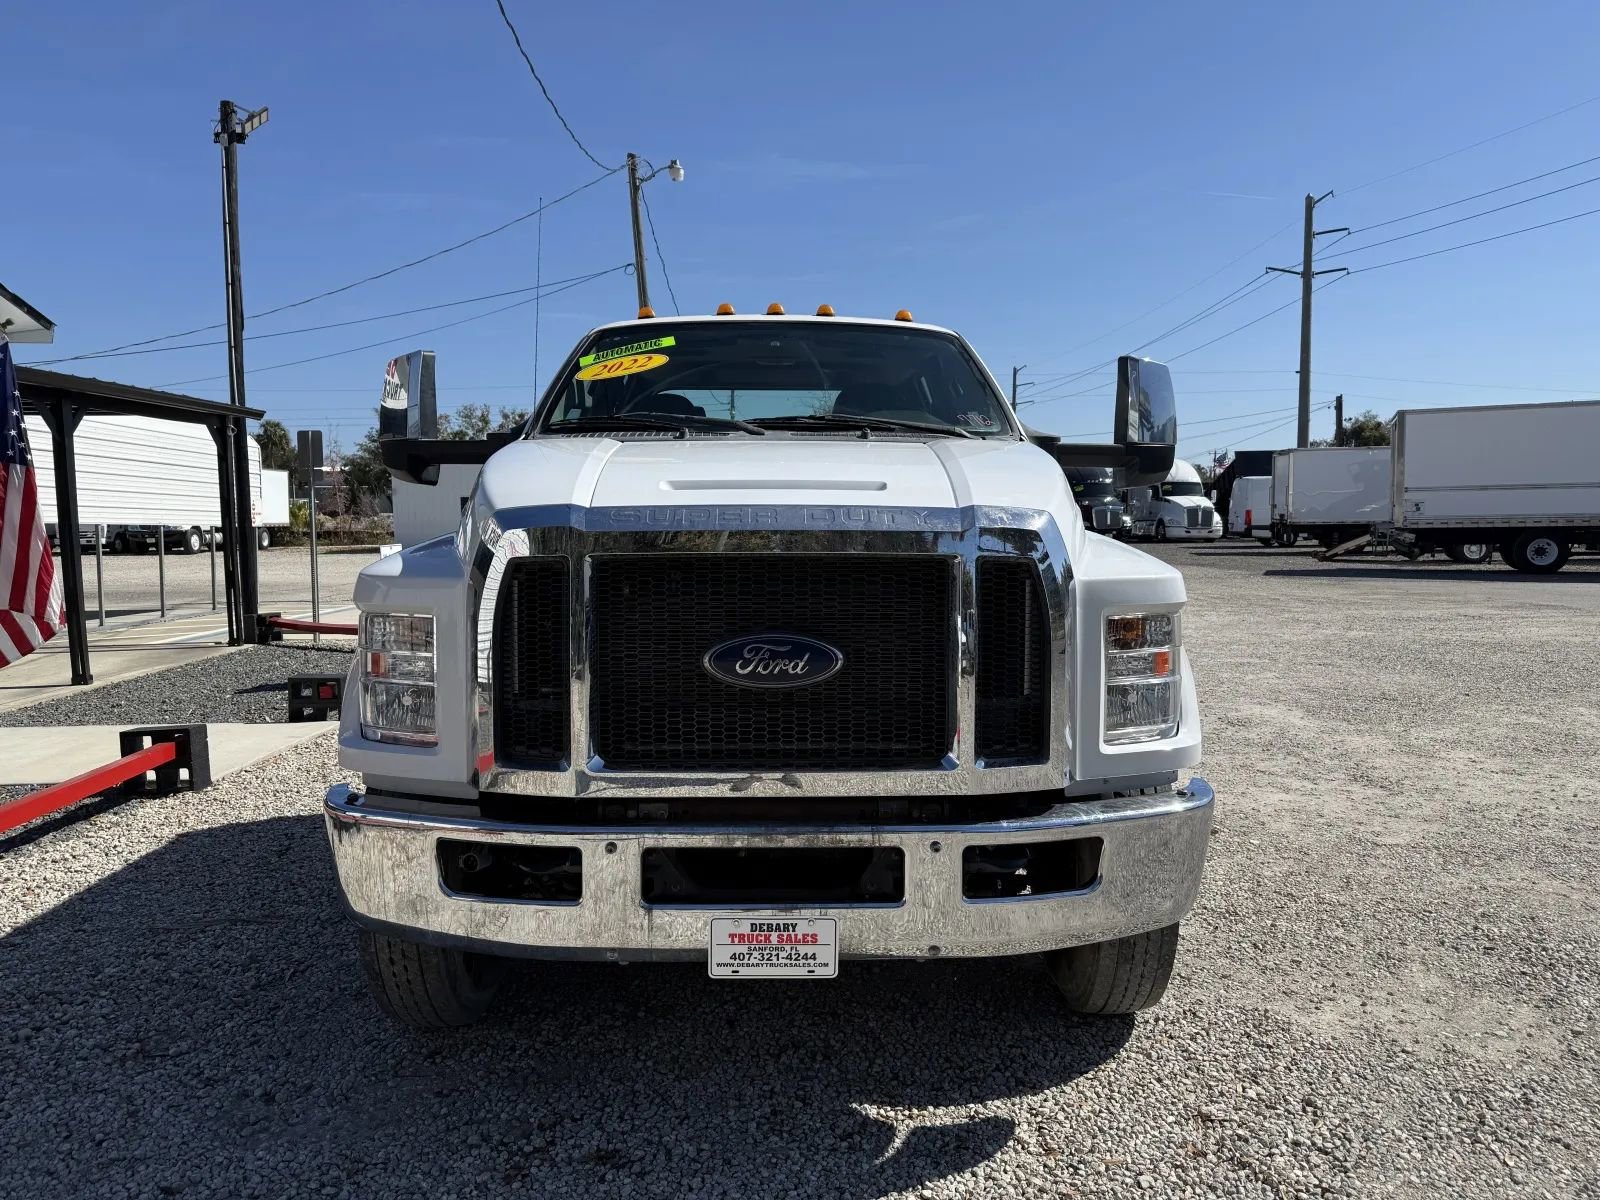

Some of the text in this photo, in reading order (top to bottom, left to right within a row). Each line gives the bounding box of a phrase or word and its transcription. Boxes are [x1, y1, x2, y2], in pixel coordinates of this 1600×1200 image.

[593, 339, 663, 362] AUTOMATIC
[591, 355, 653, 377] 2022
[608, 506, 931, 527] SUPER DUTY
[735, 643, 811, 675] Ford
[749, 922, 798, 933] DEBARY
[728, 933, 818, 944] TRUCK SALES
[729, 952, 817, 962] 407-321-4244
[747, 945, 788, 953] SANFORD,
